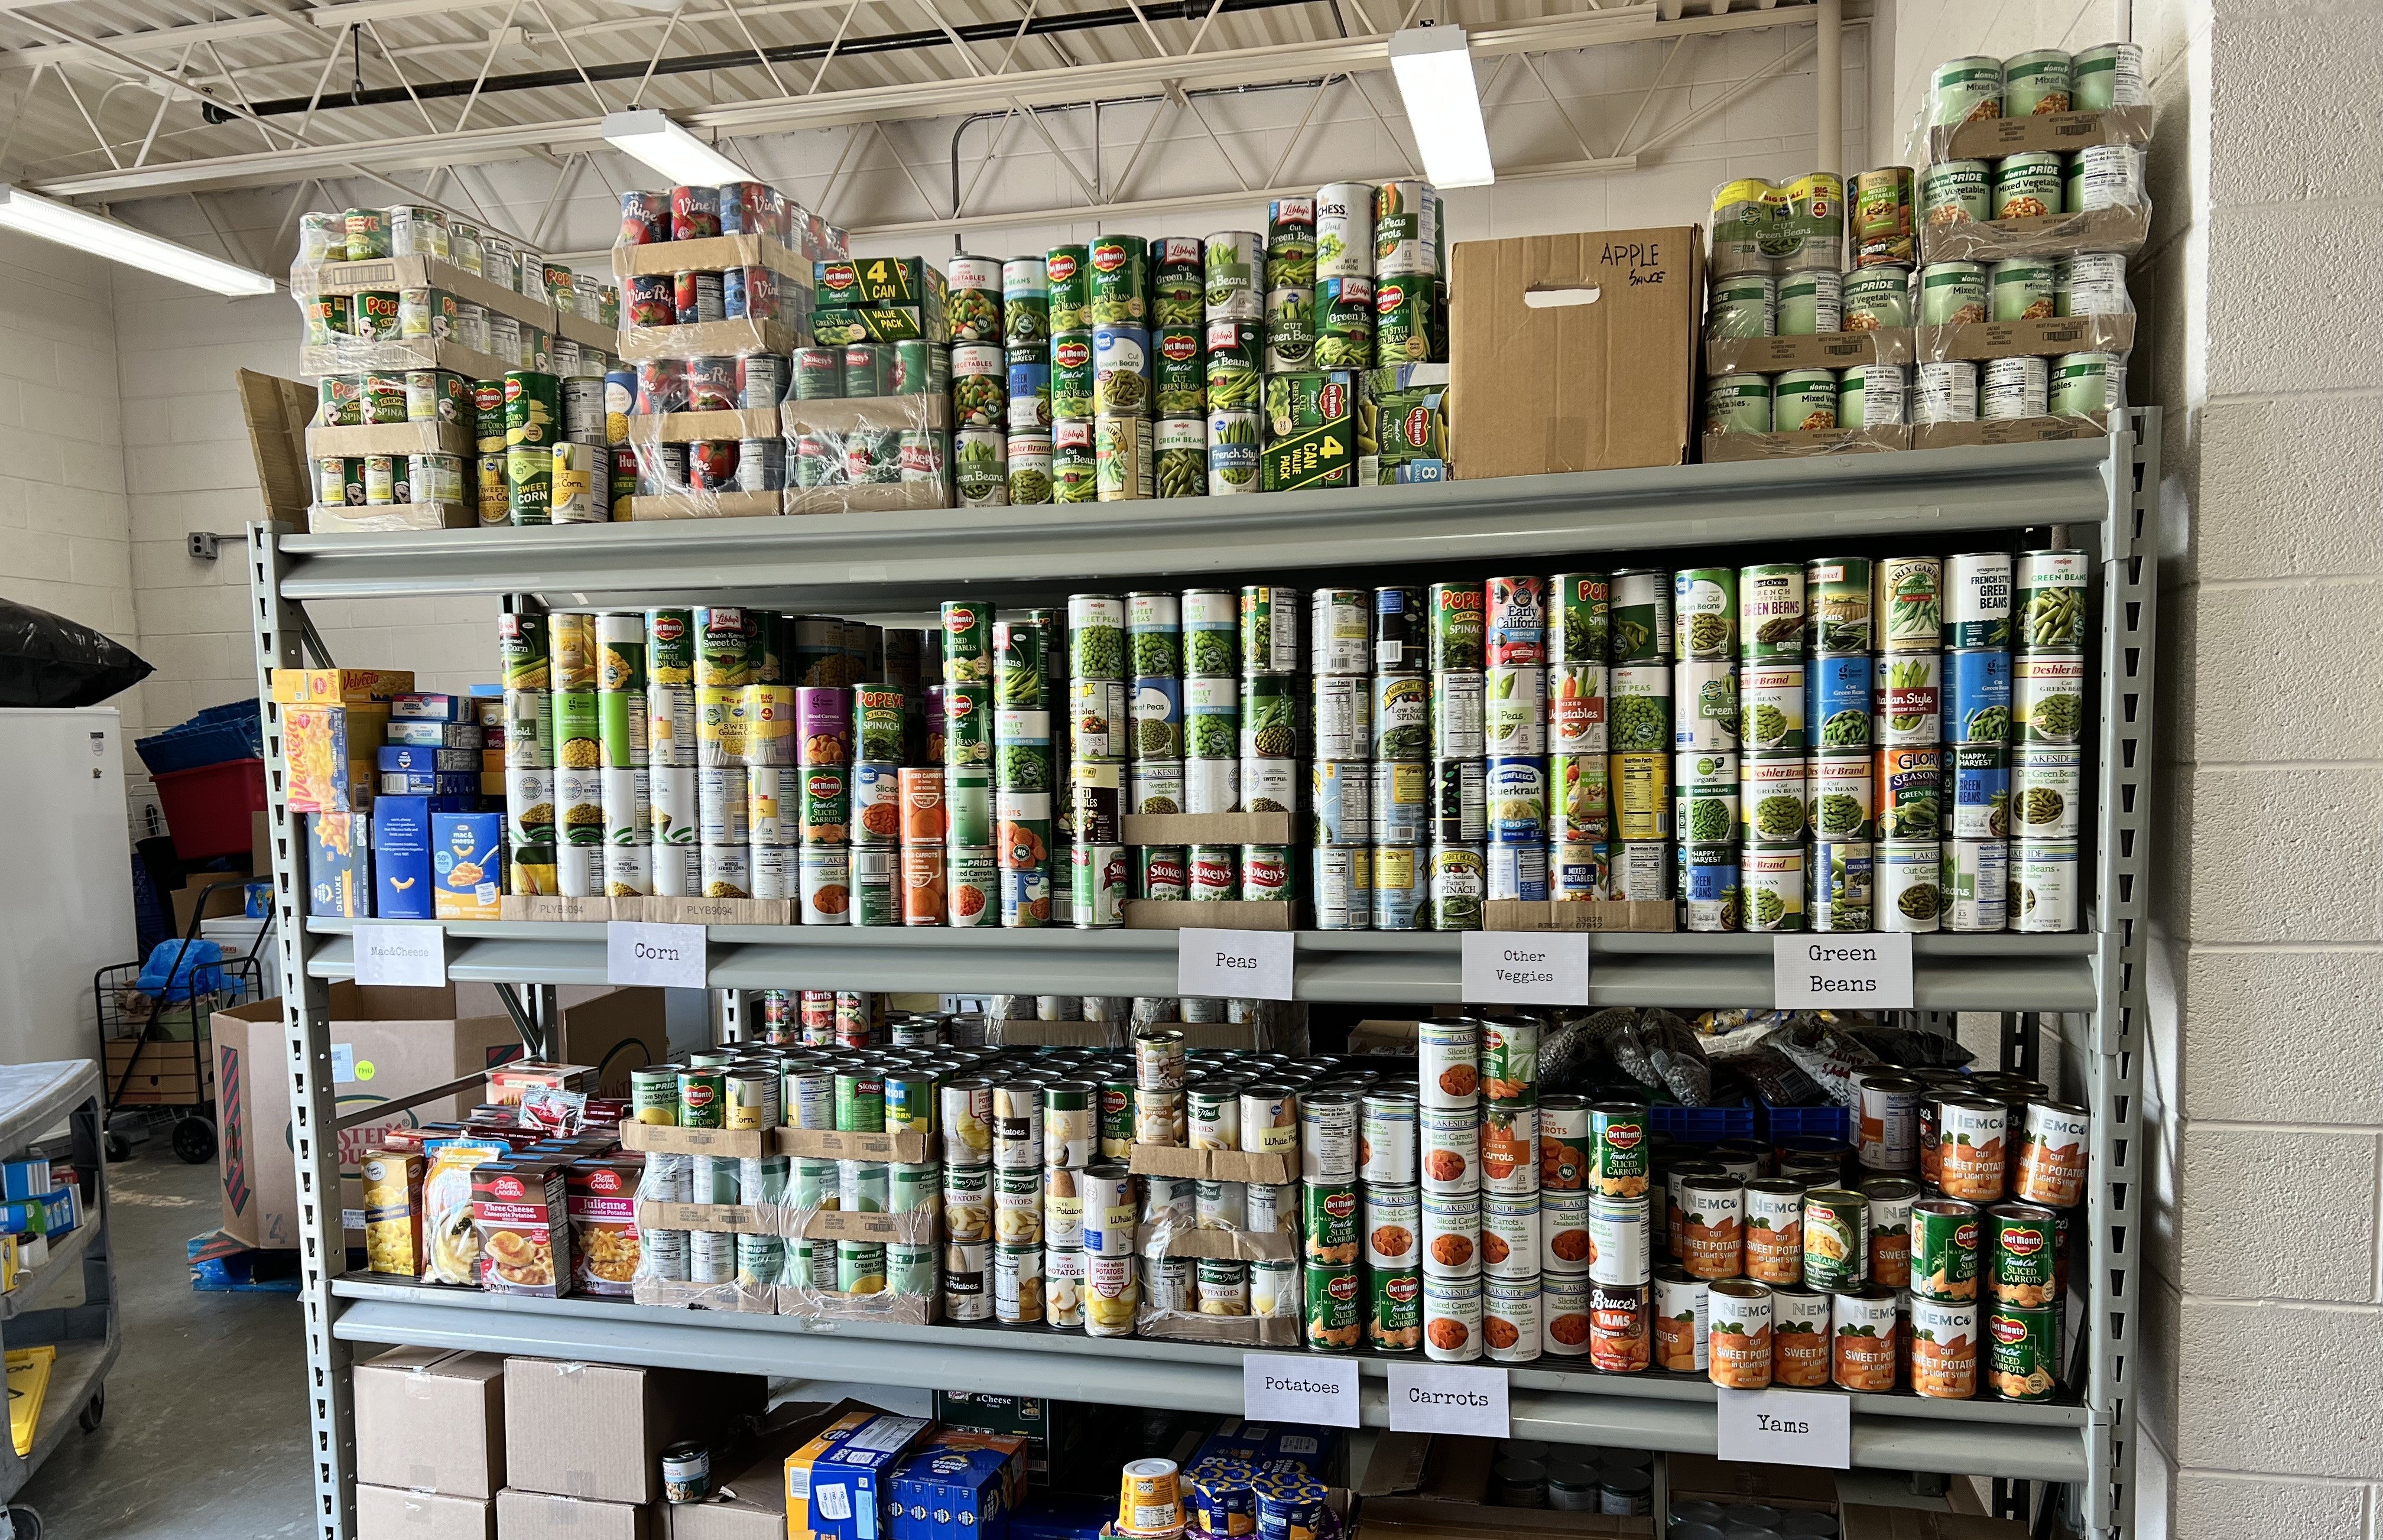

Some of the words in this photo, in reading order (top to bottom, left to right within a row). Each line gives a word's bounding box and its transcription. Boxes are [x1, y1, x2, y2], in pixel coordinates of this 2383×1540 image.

[2035, 76, 2059, 85] Mixed
[2005, 171, 2026, 179] NORTH
[2028, 167, 2058, 175] PRIDE
[1998, 183, 2021, 193] Mixed
[1861, 191, 1895, 203] VEGETABLES
[1284, 204, 1309, 216] Libby's
[1384, 218, 1405, 227] Peas
[1783, 227, 1810, 236] Beans
[1600, 243, 1658, 267] APPLE
[868, 261, 887, 282] 4
[873, 285, 895, 298] CAN
[872, 310, 895, 319] VALUE
[881, 318, 903, 328] PACK
[1055, 389, 1071, 398] GREEN
[1072, 389, 1092, 397] BEANS
[1320, 436, 1343, 459] 4
[1212, 449, 1240, 459] French
[1303, 443, 1317, 469] CAN
[1280, 456, 1290, 479] PACK
[1293, 449, 1301, 475] VALUE
[982, 471, 1004, 481] Beans
[1422, 467, 1437, 479] 8
[518, 483, 546, 494] SWEET
[518, 490, 547, 503] CORN
[1971, 576, 1996, 584] FRENCH
[1980, 586, 2007, 597] GREEN
[1772, 602, 1799, 613] BEANS
[1980, 598, 2007, 609] BEANS
[1508, 606, 1537, 619] Early
[715, 615, 739, 624] Libby's
[1496, 618, 1543, 628] California
[703, 639, 729, 648] Sweet
[2033, 666, 2067, 674] Deshler
[343, 672, 379, 690] Velveeta
[866, 711, 898, 720] CHOPPED
[1501, 711, 1524, 720] Peas
[862, 721, 900, 731] SPINACH
[285, 713, 311, 805] Velveeta
[1959, 780, 1981, 791] GREEN
[1959, 792, 1981, 803] BEANS
[968, 859, 994, 867] PRIDE
[1757, 860, 1785, 868] Brand
[540, 905, 583, 914] PLYB9094
[687, 906, 732, 915] PLYB9094
[371, 947, 428, 957] Mac&Cheese
[635, 943, 679, 960] Corn
[1504, 950, 1545, 961] Other
[1809, 946, 1876, 961] Green
[1216, 953, 1257, 969] Peas
[1496, 970, 1553, 983] Veggies
[1810, 976, 1876, 992] Beans
[1562, 1168, 1572, 1176] NO
[496, 1180, 517, 1191] Betty
[494, 1190, 523, 1200] Crocker
[583, 1200, 627, 1210] Julienne
[2004, 1234, 2017, 1243] Del
[2018, 1235, 2040, 1244] Monte
[1820, 1256, 1840, 1268] YAMS
[2007, 1265, 2037, 1275] SLICED
[1225, 1272, 1241, 1281] Maid
[2002, 1273, 2041, 1284] CARROTS
[1590, 1289, 1637, 1310] Bruce's
[1599, 1314, 1629, 1325] YAMS
[1266, 1377, 1339, 1393] Potatoes
[1409, 1388, 1488, 1406] Carrots
[1757, 1414, 1809, 1434] Yams
